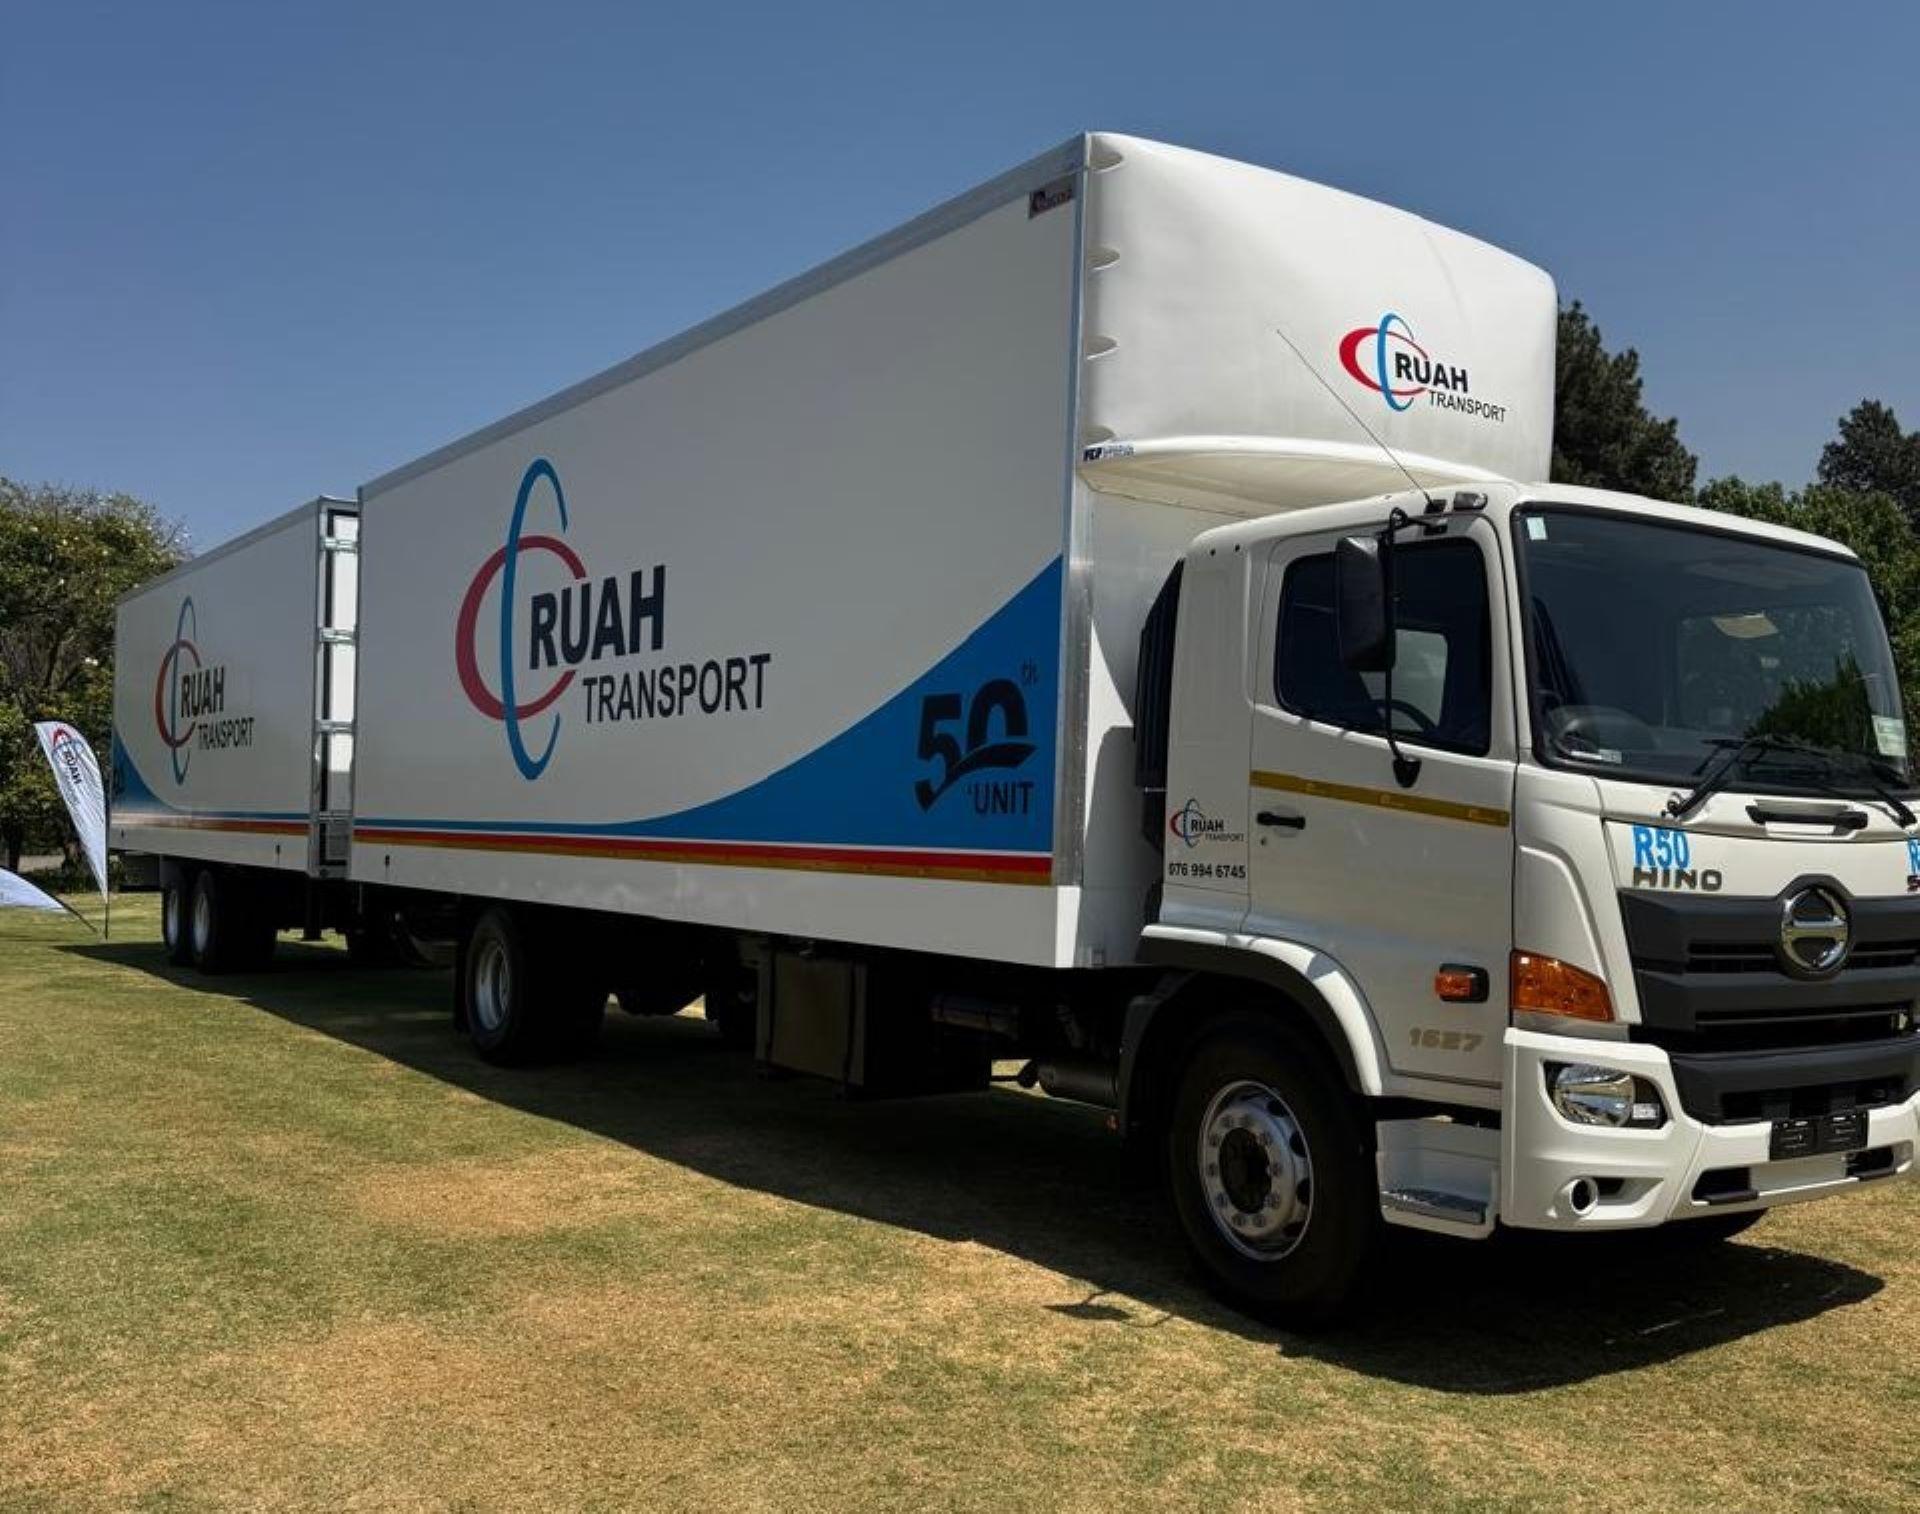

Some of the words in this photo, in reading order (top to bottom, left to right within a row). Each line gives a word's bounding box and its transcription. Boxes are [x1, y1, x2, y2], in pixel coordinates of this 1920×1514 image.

[1394, 351, 1468, 393] RUAH
[1427, 389, 1506, 422] TRANSPORT
[529, 564, 666, 670] RUAH
[181, 666, 224, 718] RUAH
[582, 652, 771, 724] TRANSPORT
[198, 717, 254, 750] TRANSPORT
[1191, 820, 1224, 832] RUAH
[1633, 824, 1690, 870] R50
[1169, 863, 1187, 876] 076
[1191, 863, 1212, 877] 994
[1215, 865, 1246, 878] 6745
[1633, 867, 1722, 891] HINO
